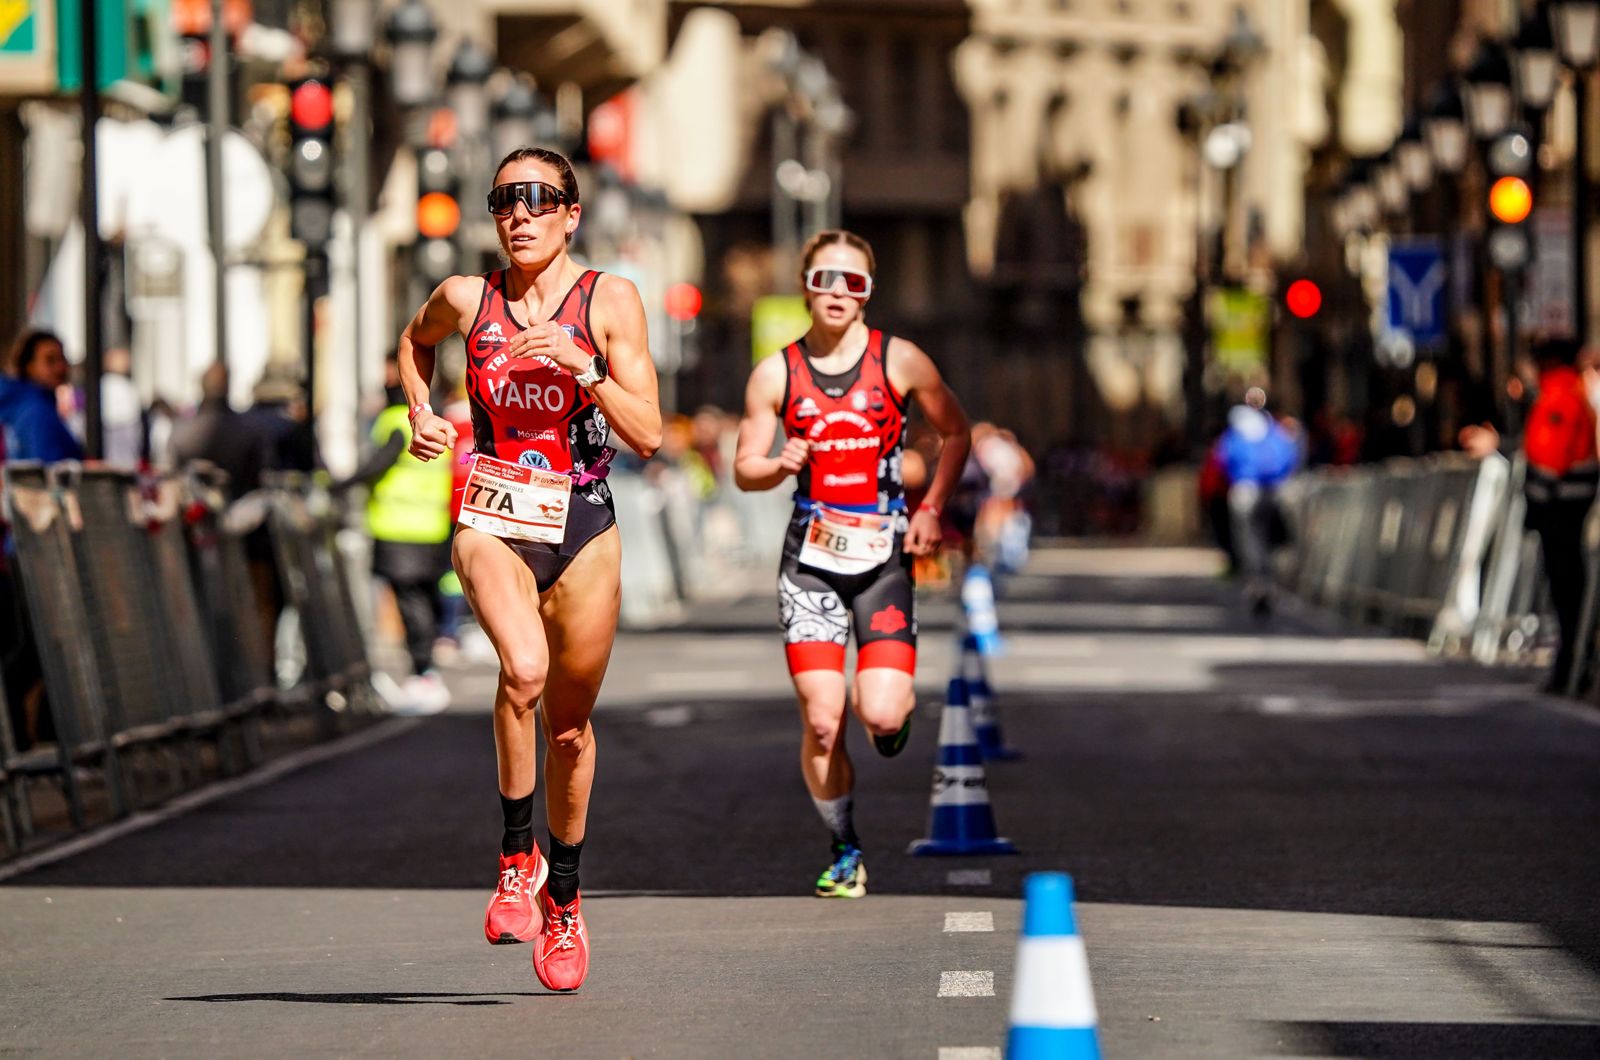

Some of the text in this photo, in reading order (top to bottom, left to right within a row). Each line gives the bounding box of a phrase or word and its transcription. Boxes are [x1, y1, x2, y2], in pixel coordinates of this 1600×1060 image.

[487, 353, 509, 372] TRI
[487, 378, 565, 412] VARO
[517, 429, 556, 441] Móstoles
[469, 483, 514, 515] 77A
[813, 526, 848, 552] 77B
